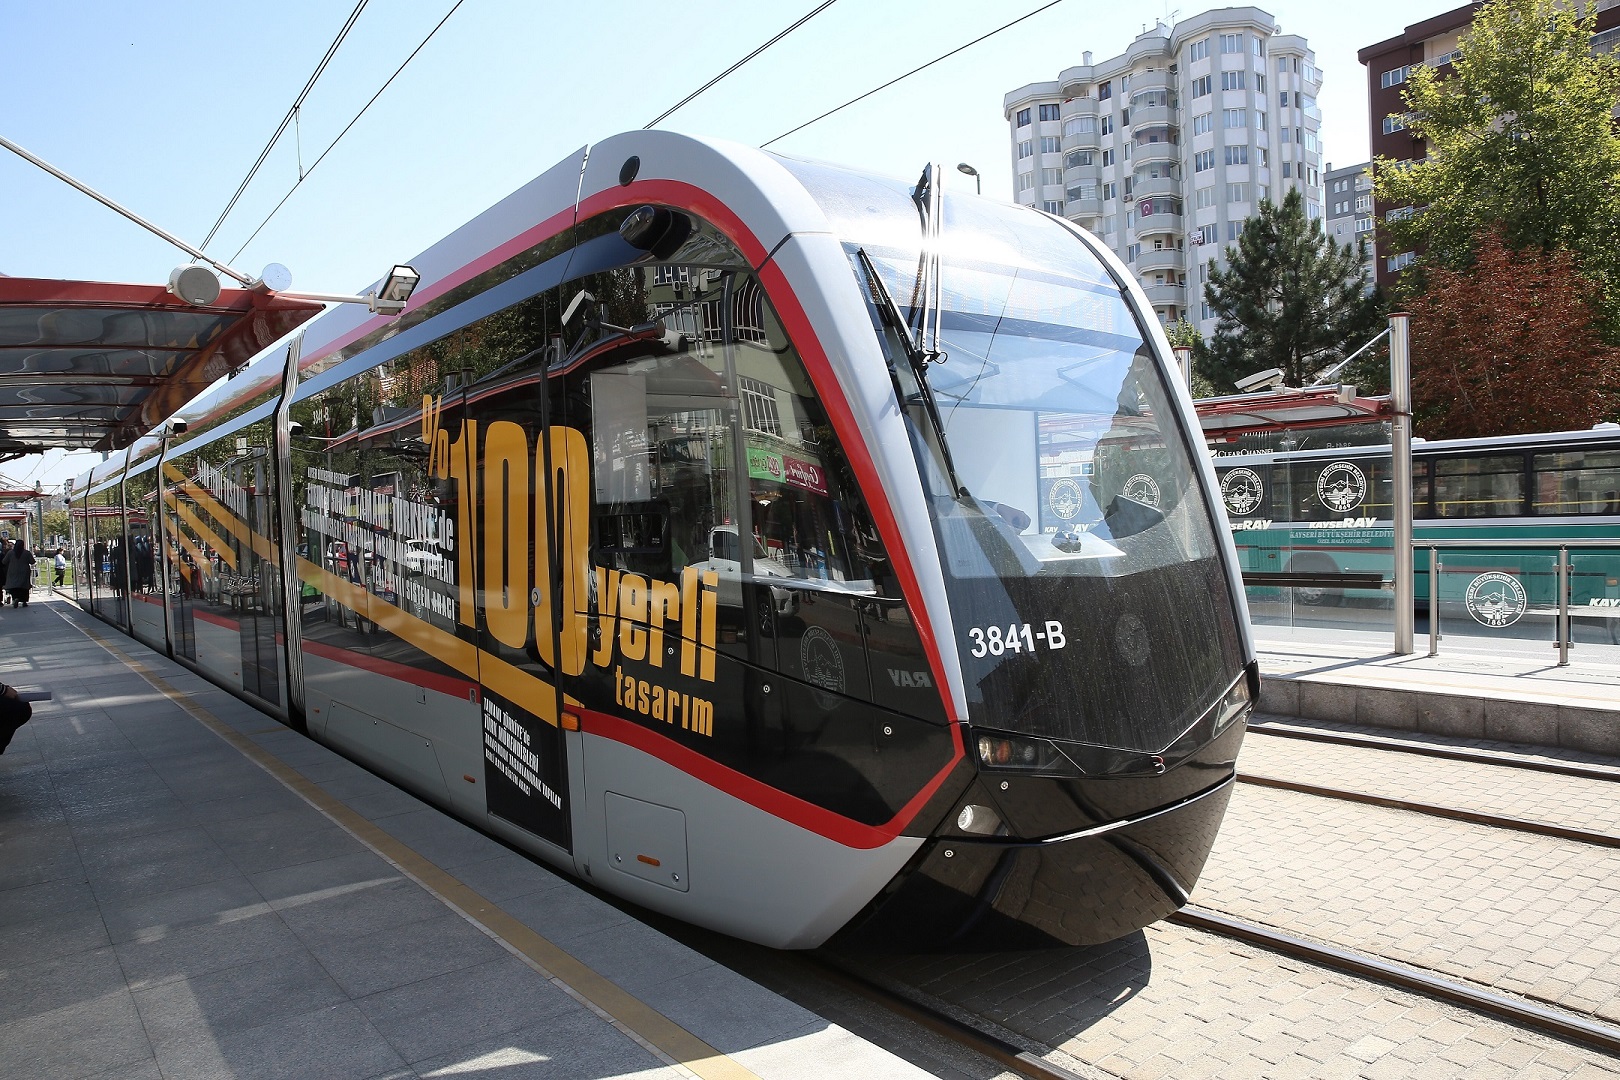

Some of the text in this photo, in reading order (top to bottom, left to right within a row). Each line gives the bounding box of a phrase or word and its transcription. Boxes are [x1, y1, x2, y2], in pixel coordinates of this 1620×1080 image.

[422, 394, 589, 676] %100
[593, 566, 719, 682] yerli
[1589, 597, 1620, 607] KAY
[968, 620, 1067, 658] 3841-B
[615, 665, 714, 738] tasarım
